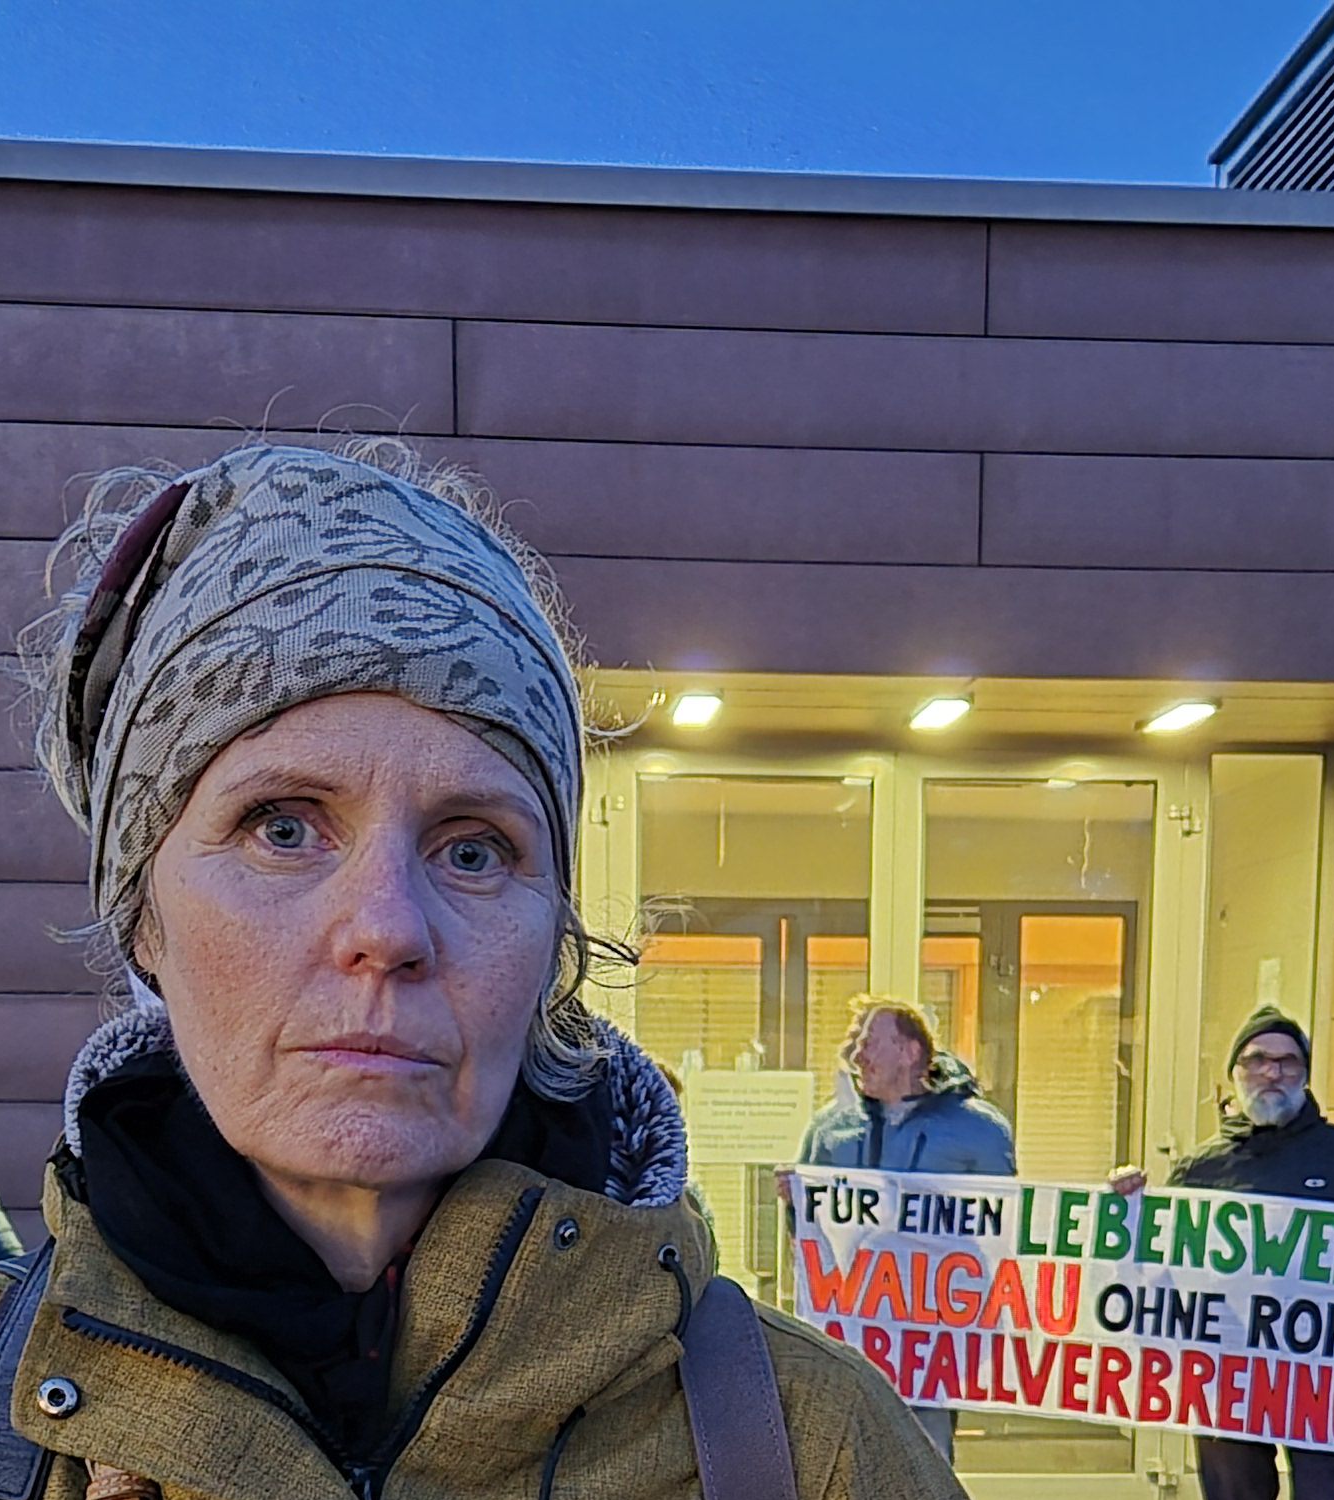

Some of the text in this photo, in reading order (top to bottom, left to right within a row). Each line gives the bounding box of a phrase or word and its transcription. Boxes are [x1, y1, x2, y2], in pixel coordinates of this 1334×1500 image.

[805, 1176, 879, 1225] FÜR
[898, 1193, 1003, 1236] EINEN
[801, 1238, 1082, 1336] WALGAU
[1095, 1283, 1226, 1342] OHNE
